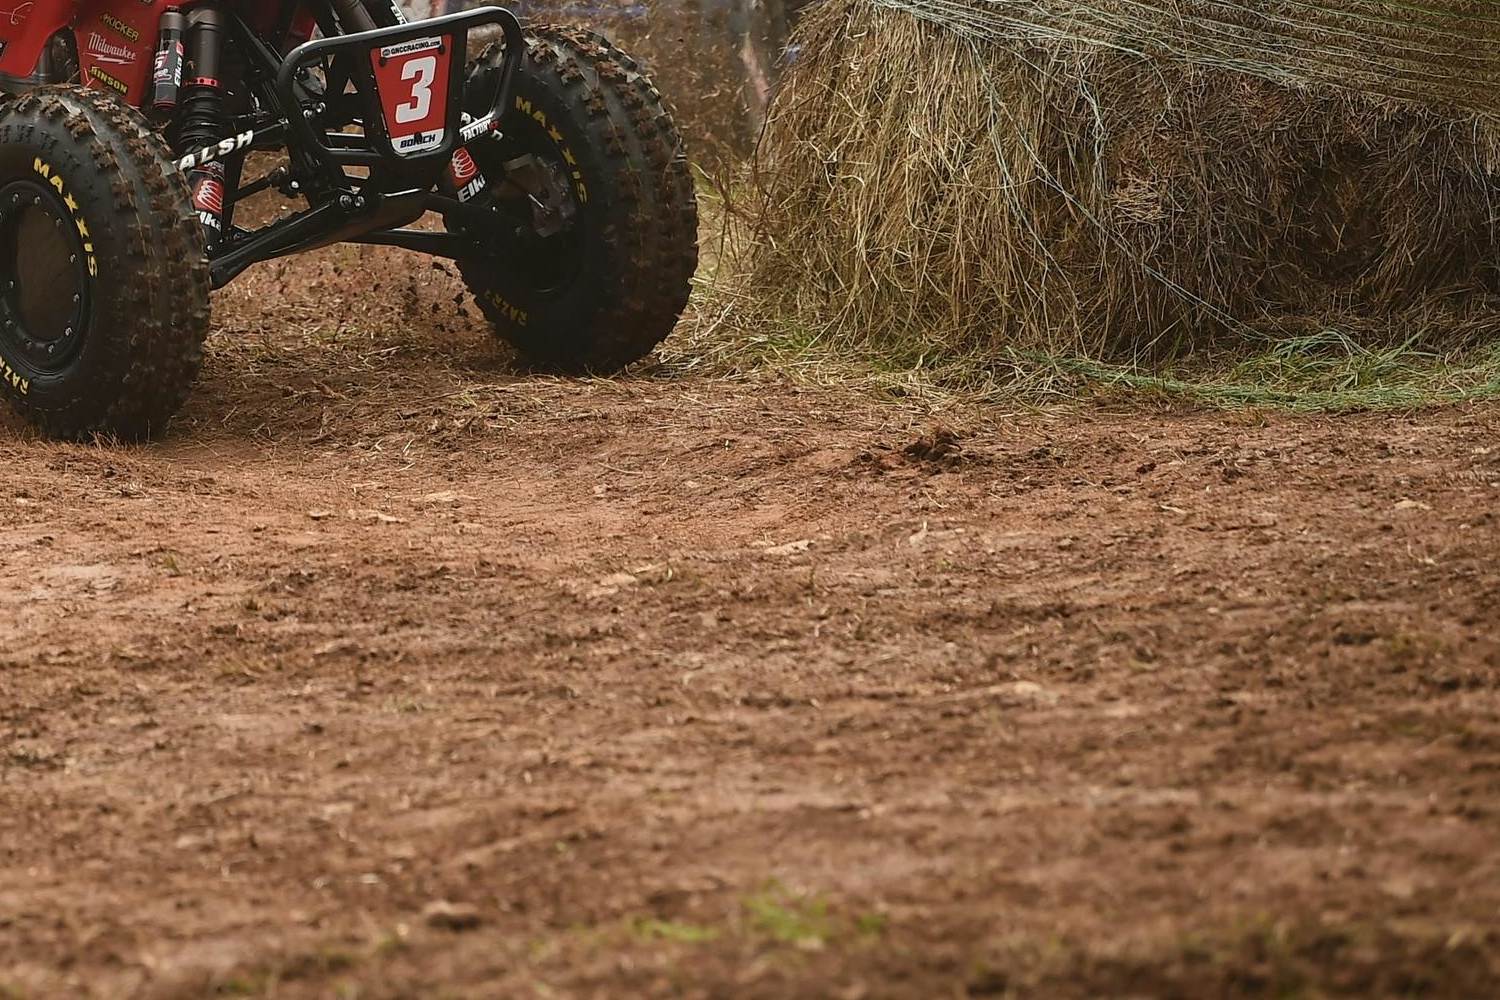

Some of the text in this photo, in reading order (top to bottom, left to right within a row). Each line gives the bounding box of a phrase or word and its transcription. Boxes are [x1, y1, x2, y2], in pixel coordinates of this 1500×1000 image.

[88, 31, 137, 60] Milwaukee
[107, 14, 140, 42] KICKER
[91, 65, 128, 95] HINSON
[395, 55, 437, 125] 3
[171, 129, 254, 171] ALSH
[400, 133, 436, 149] BOCH
[515, 95, 588, 203] MAXXIS
[33, 156, 98, 278] MAXXIS
